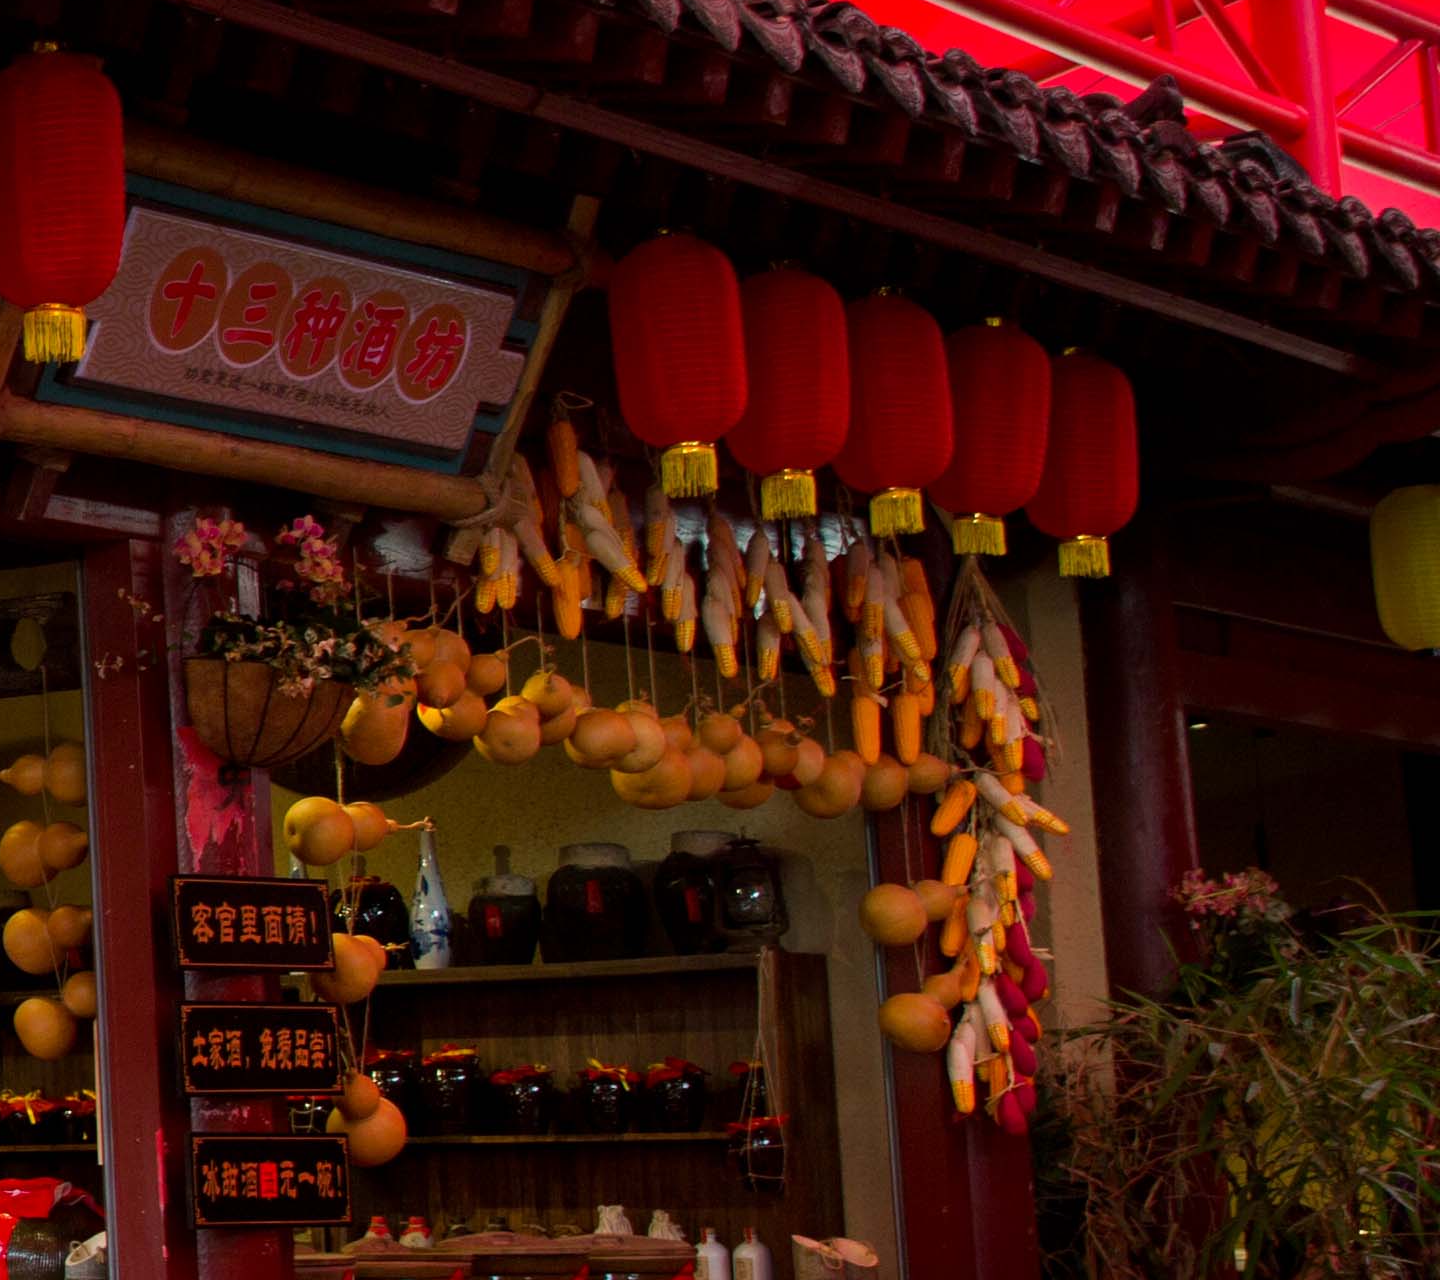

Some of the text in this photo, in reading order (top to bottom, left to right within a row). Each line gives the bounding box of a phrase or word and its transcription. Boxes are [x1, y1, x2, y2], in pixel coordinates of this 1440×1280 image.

[160, 260, 467, 391] 十三种酒坊
